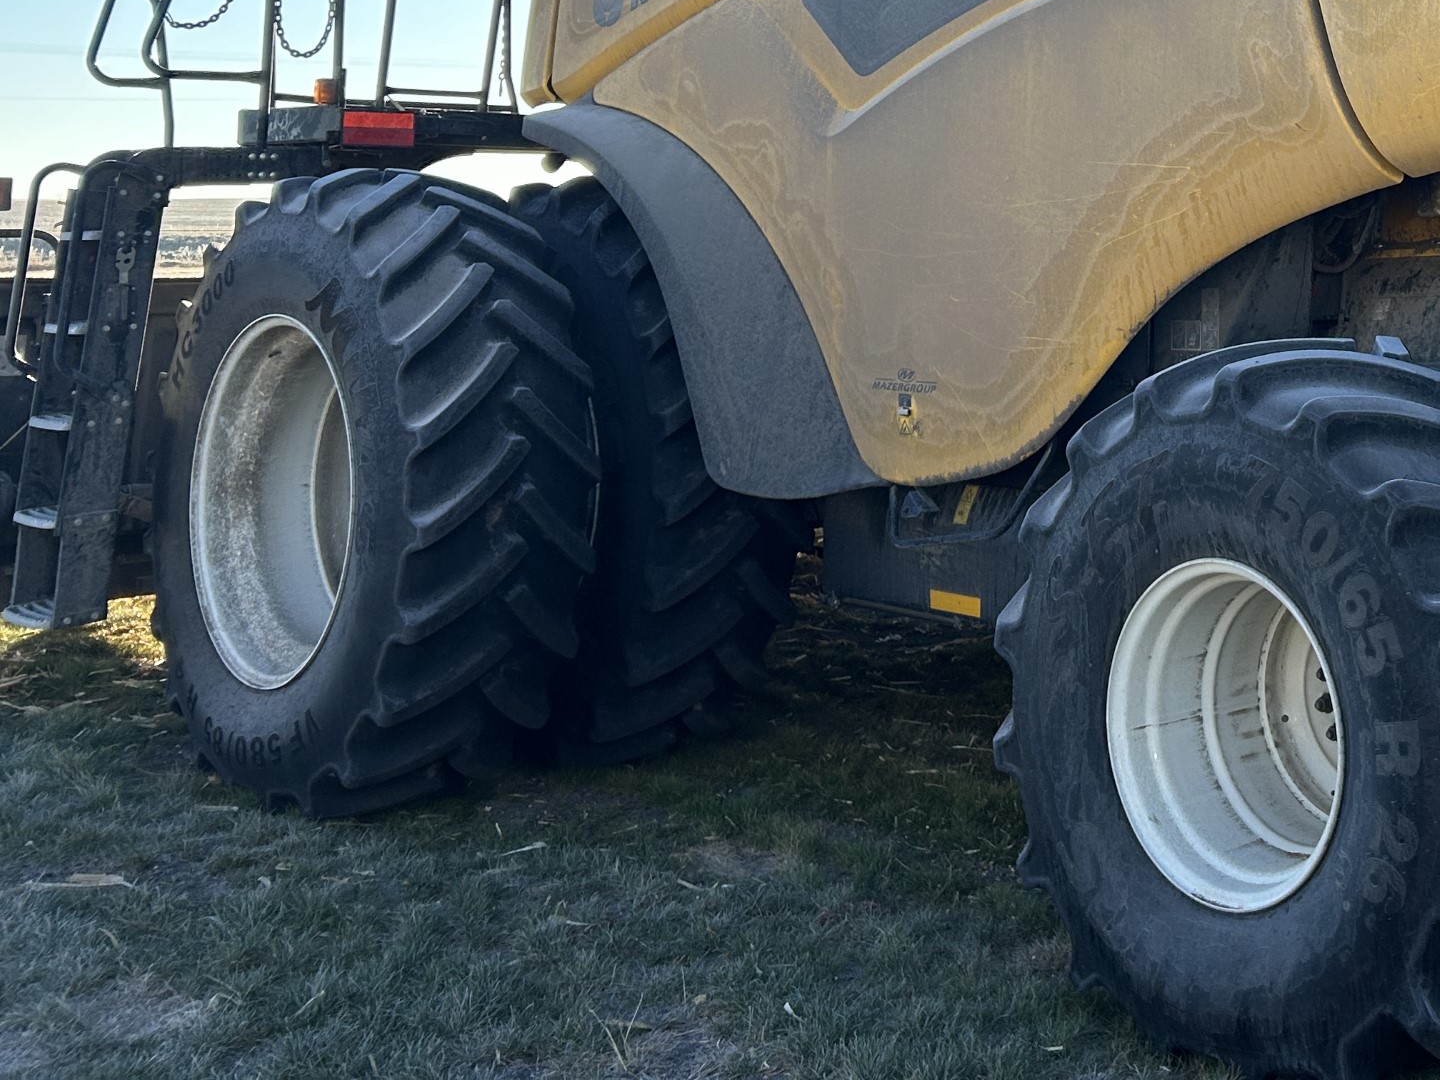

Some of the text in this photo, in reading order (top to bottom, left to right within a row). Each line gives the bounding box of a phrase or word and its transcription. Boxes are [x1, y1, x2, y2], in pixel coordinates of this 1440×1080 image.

[872, 381, 937, 393] MAZERGROUP
[203, 716, 282, 769] 580/85
[1375, 720, 1421, 777] R
